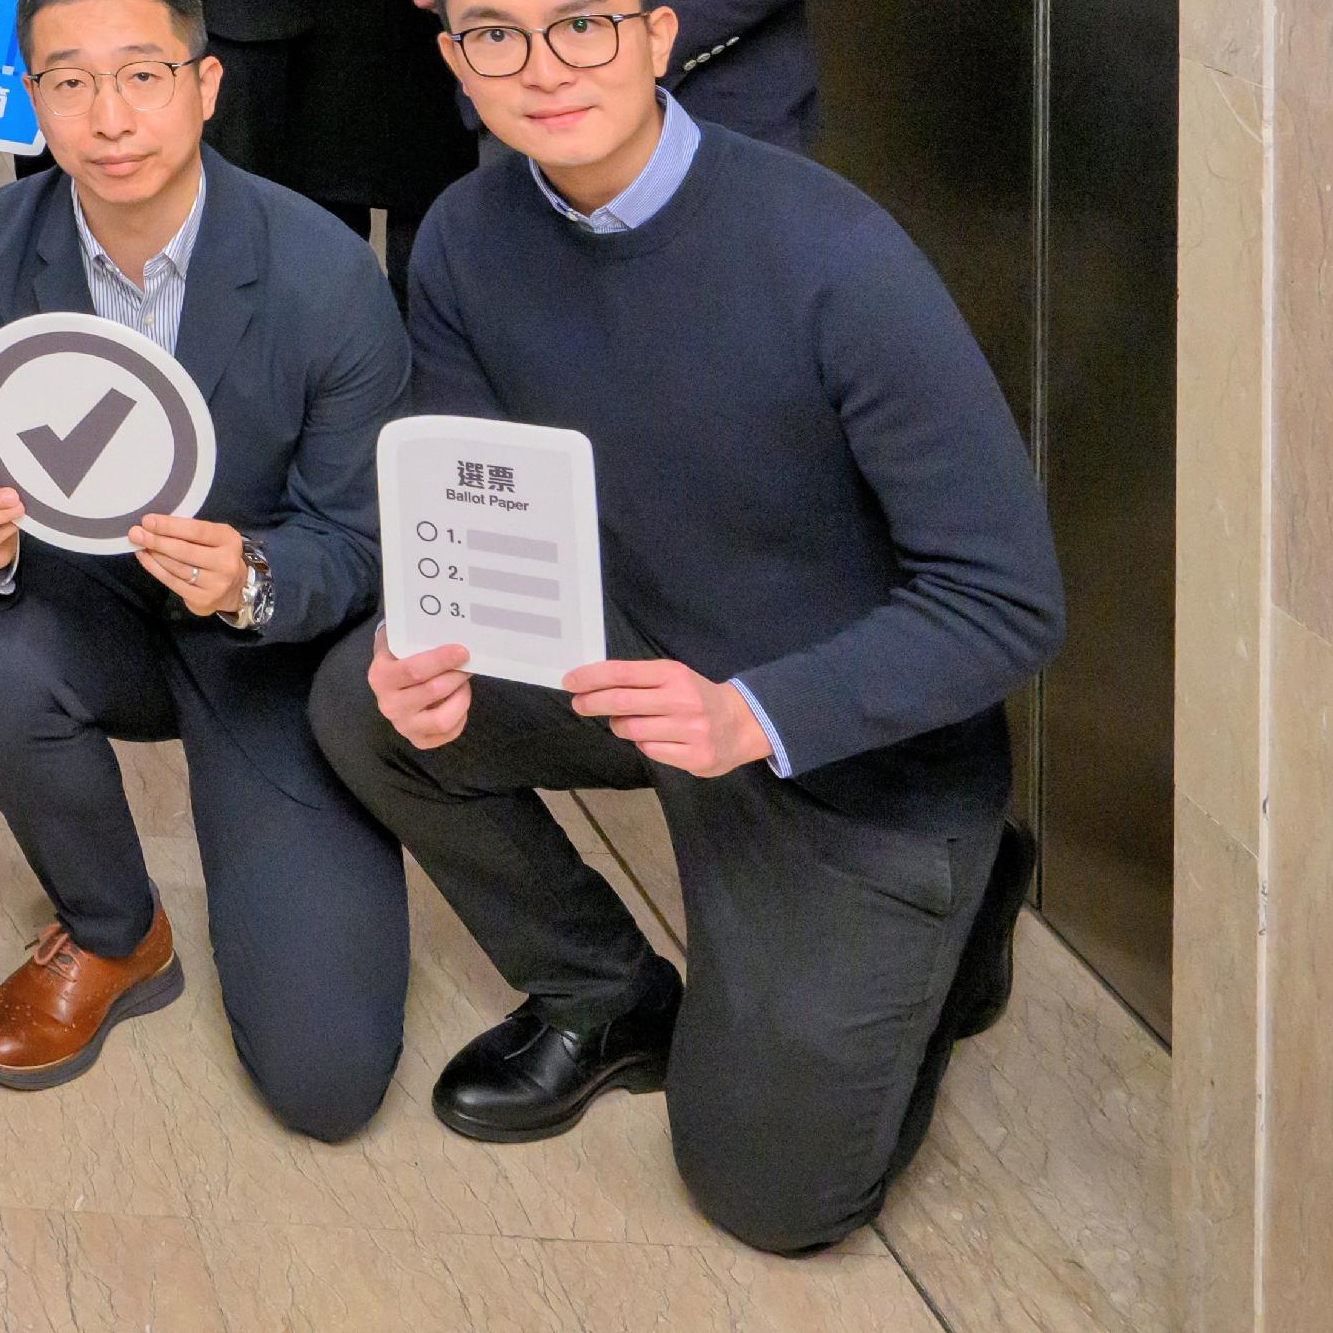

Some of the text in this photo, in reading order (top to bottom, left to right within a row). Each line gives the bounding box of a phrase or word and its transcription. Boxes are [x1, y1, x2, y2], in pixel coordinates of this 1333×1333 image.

[457, 460, 515, 494] 選票
[446, 488, 530, 512] Ballot Paper
[446, 528, 463, 544] 1.
[447, 566, 465, 582] 2.
[449, 602, 466, 618] 3.
